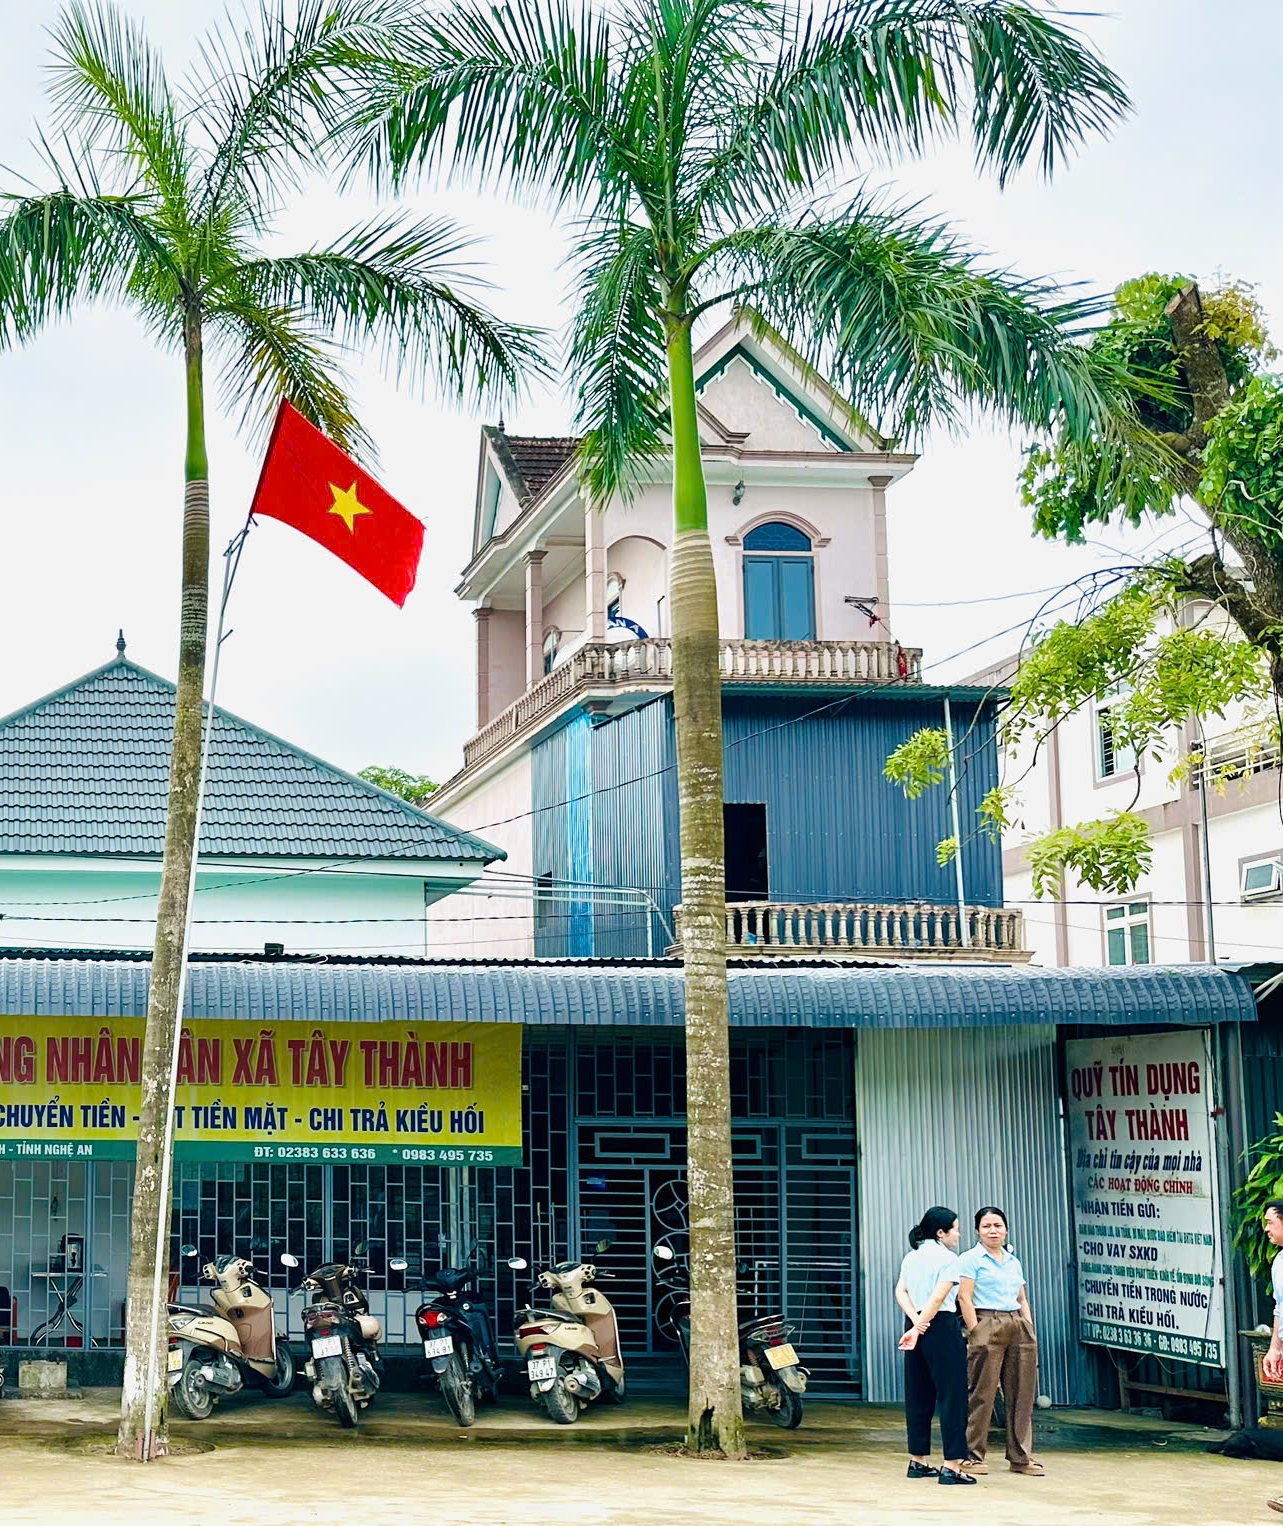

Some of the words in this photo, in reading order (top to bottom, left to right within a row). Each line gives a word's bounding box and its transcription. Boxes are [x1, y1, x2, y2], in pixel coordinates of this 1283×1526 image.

[46, 1027, 140, 1085] NHÂN
[175, 1028, 222, 1085] ÂN
[231, 1029, 278, 1086] XÃ
[288, 1028, 350, 1087] TÂY
[360, 1031, 473, 1089] THÀNH
[1071, 1060, 1103, 1101] QUỸ
[1109, 1058, 1140, 1096] TÍN
[1146, 1061, 1200, 1101] DỤNG
[80, 1098, 126, 1129] TIỀN
[192, 1099, 237, 1129] TIỀN
[244, 1102, 288, 1135] MẶT
[309, 1107, 343, 1131] CHI
[350, 1101, 390, 1132] TRẢ
[396, 1102, 443, 1133] KIỀU
[450, 1102, 485, 1134] HỐI
[1085, 1104, 1116, 1141] TÂY
[1125, 1103, 1189, 1141] THÀNH
[17, 1140, 41, 1155] TỈNH
[45, 1142, 74, 1157] NGHỆ
[77, 1145, 93, 1156] AN
[254, 1146, 274, 1157] ĐT:
[278, 1147, 318, 1158] 02383
[323, 1148, 347, 1159] 633
[351, 1148, 376, 1159] 636
[402, 1149, 436, 1160] 0983
[439, 1150, 465, 1161] 495
[468, 1150, 493, 1161] 735
[1124, 1149, 1142, 1174] cậy
[1143, 1148, 1160, 1171] của
[1163, 1150, 1182, 1175] mọi
[1183, 1150, 1202, 1171] nhà
[1108, 1177, 1131, 1193] HOẠT
[1134, 1176, 1160, 1194] ĐỘNG
[1107, 1243, 1126, 1258] VAY
[1129, 1245, 1158, 1261] SXKD
[1145, 1286, 1176, 1305] TRONG
[1180, 1288, 1208, 1309] NƯỚC
[1107, 1301, 1125, 1322] TRẢ
[1118, 1327, 1123, 1342] 3
[1124, 1328, 1133, 1344] 63
[1133, 1330, 1141, 1346] 36
[1143, 1331, 1152, 1348] 36
[1204, 1342, 1218, 1359] 735
